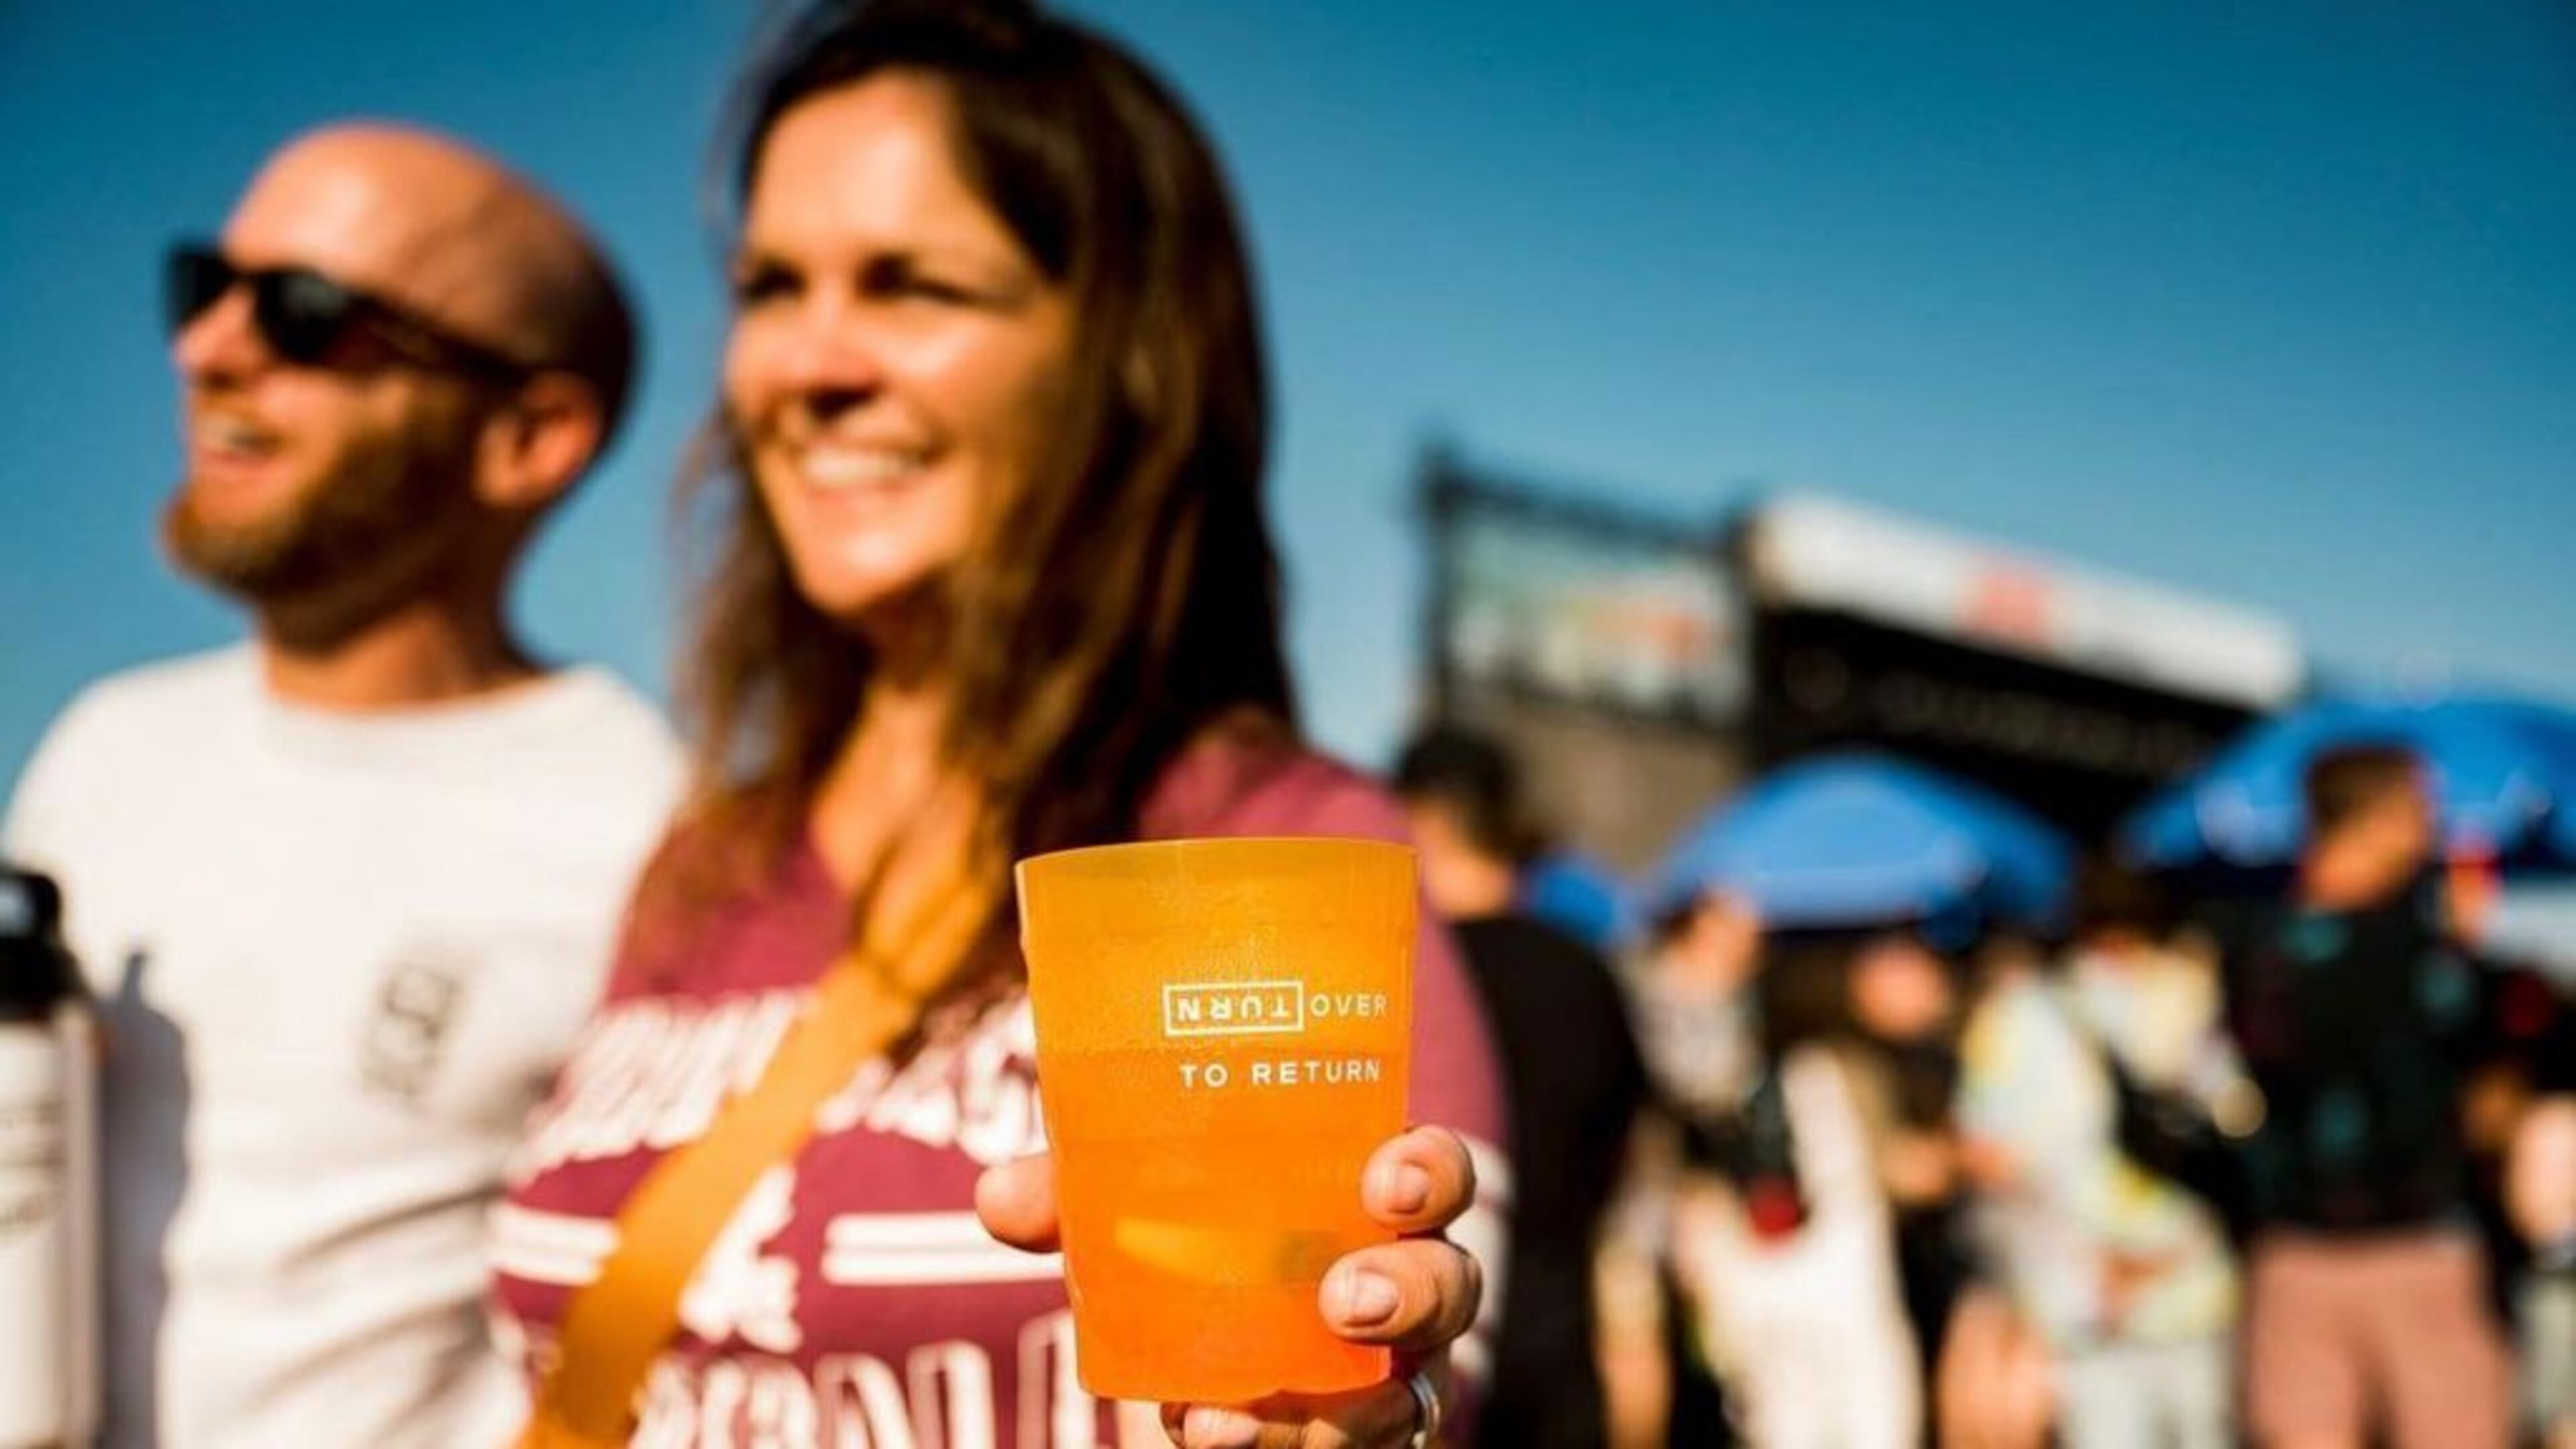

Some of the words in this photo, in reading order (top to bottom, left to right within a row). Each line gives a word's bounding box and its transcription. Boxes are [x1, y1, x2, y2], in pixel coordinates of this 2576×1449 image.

[1178, 996, 1289, 1020] TURN
[1311, 993, 1387, 1016] OVER
[1179, 1063, 1228, 1087] TO
[1252, 1060, 1380, 1084] RETURN
